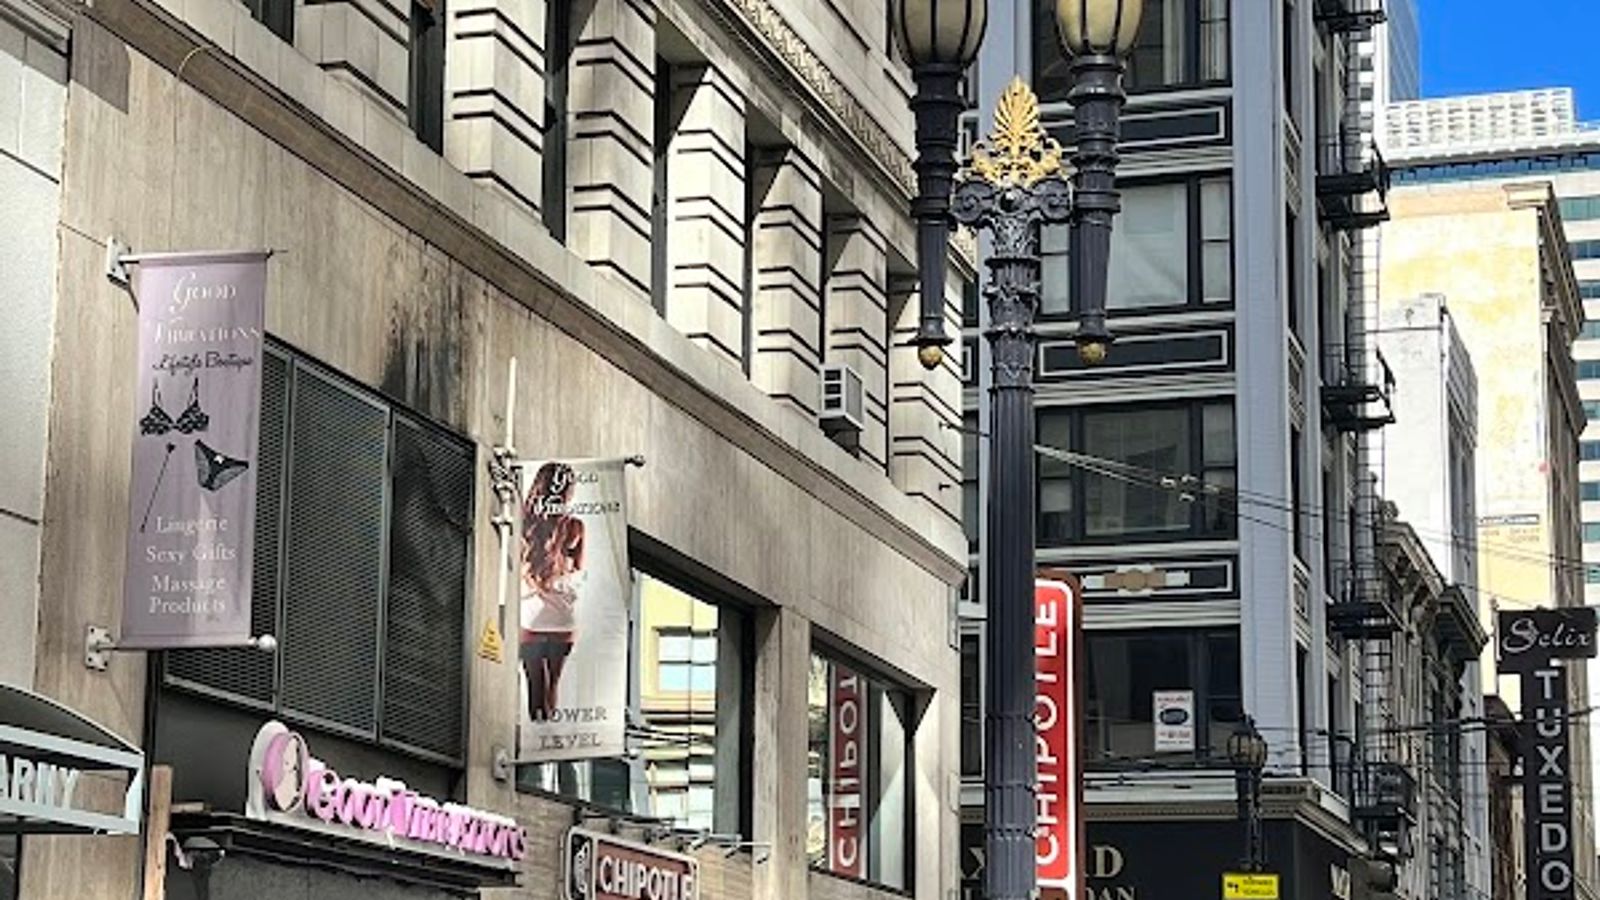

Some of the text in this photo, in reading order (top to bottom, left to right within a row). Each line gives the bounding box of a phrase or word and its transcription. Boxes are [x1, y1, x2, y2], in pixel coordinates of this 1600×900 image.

[156, 515, 228, 536] Lingerie
[146, 543, 237, 565] Sexy Gifts
[151, 575, 226, 594] Massage
[149, 597, 226, 615] Products
[1502, 618, 1593, 654] Selix
[539, 732, 603, 750] LEVEL
[1534, 670, 1573, 892] TUXEDO
